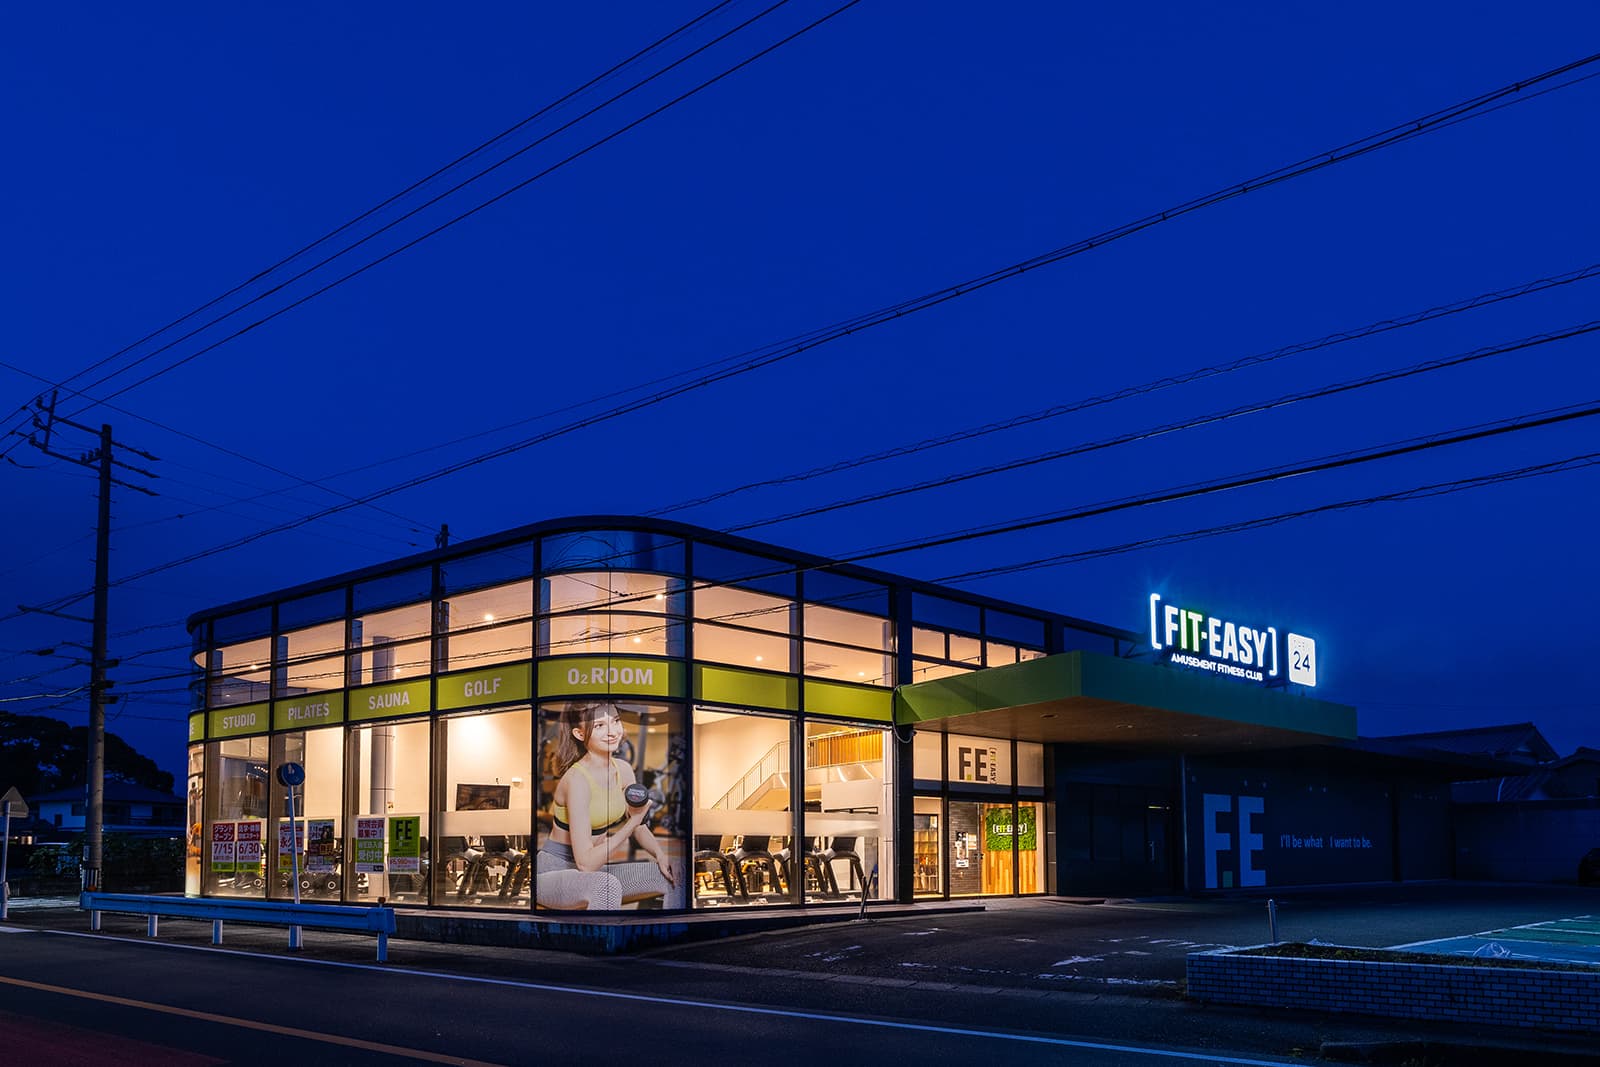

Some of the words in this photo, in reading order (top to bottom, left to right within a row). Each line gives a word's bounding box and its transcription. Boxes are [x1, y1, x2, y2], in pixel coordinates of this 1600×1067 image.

[1171, 653, 1217, 671] AMUSEMENT
[1217, 662, 1245, 677] FITNESS
[1245, 669, 1263, 681] CLUB
[1293, 650, 1311, 672] 24
[591, 667, 653, 685] ROOM
[464, 678, 502, 697] GOLF
[368, 691, 410, 710] SAUNA
[288, 703, 330, 720] PILATES
[223, 713, 256, 730] STUDIO
[214, 843, 233, 854] 7/15
[238, 842, 260, 854] 6/30
[1292, 834, 1303, 848] be
[1304, 835, 1323, 848] what
[1334, 837, 1352, 848] want
[1353, 837, 1360, 848] to
